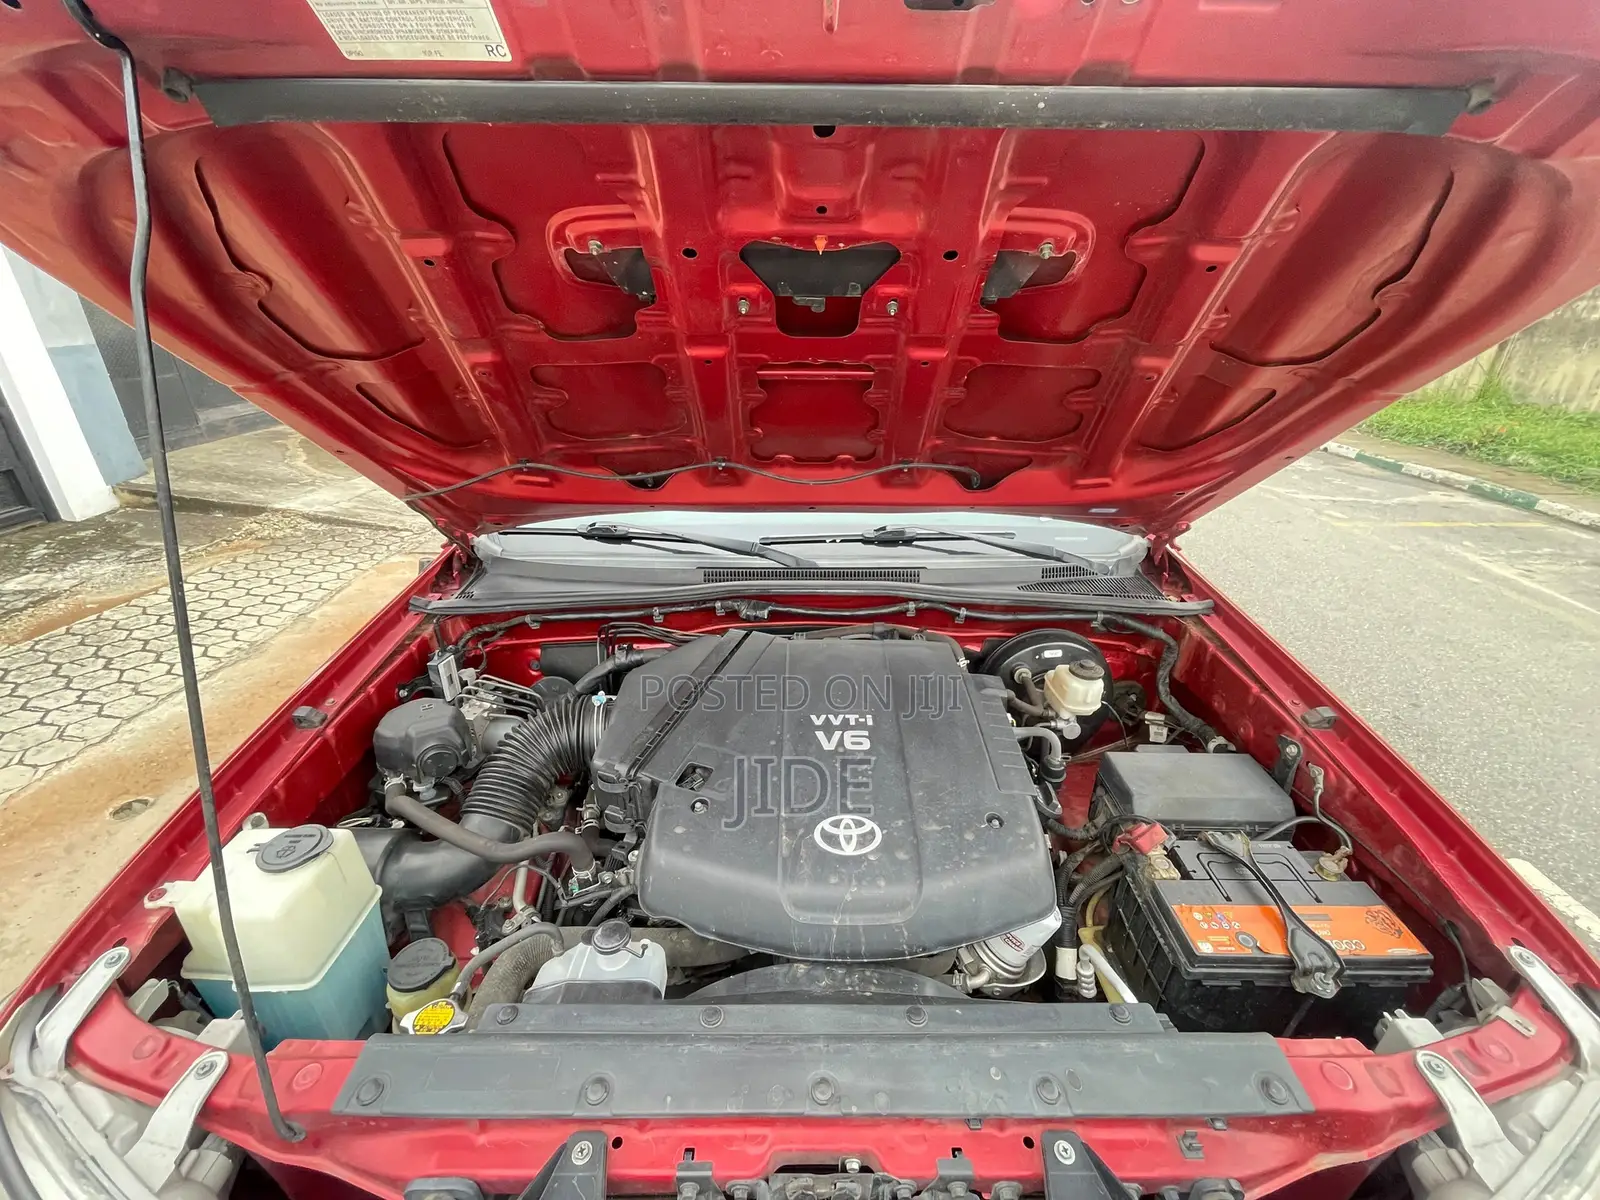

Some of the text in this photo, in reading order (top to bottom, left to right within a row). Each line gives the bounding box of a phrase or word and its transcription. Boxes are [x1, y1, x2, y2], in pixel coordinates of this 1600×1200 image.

[485, 45, 507, 57] RC
[810, 714, 874, 726] VVT-i
[814, 730, 871, 751] V6
